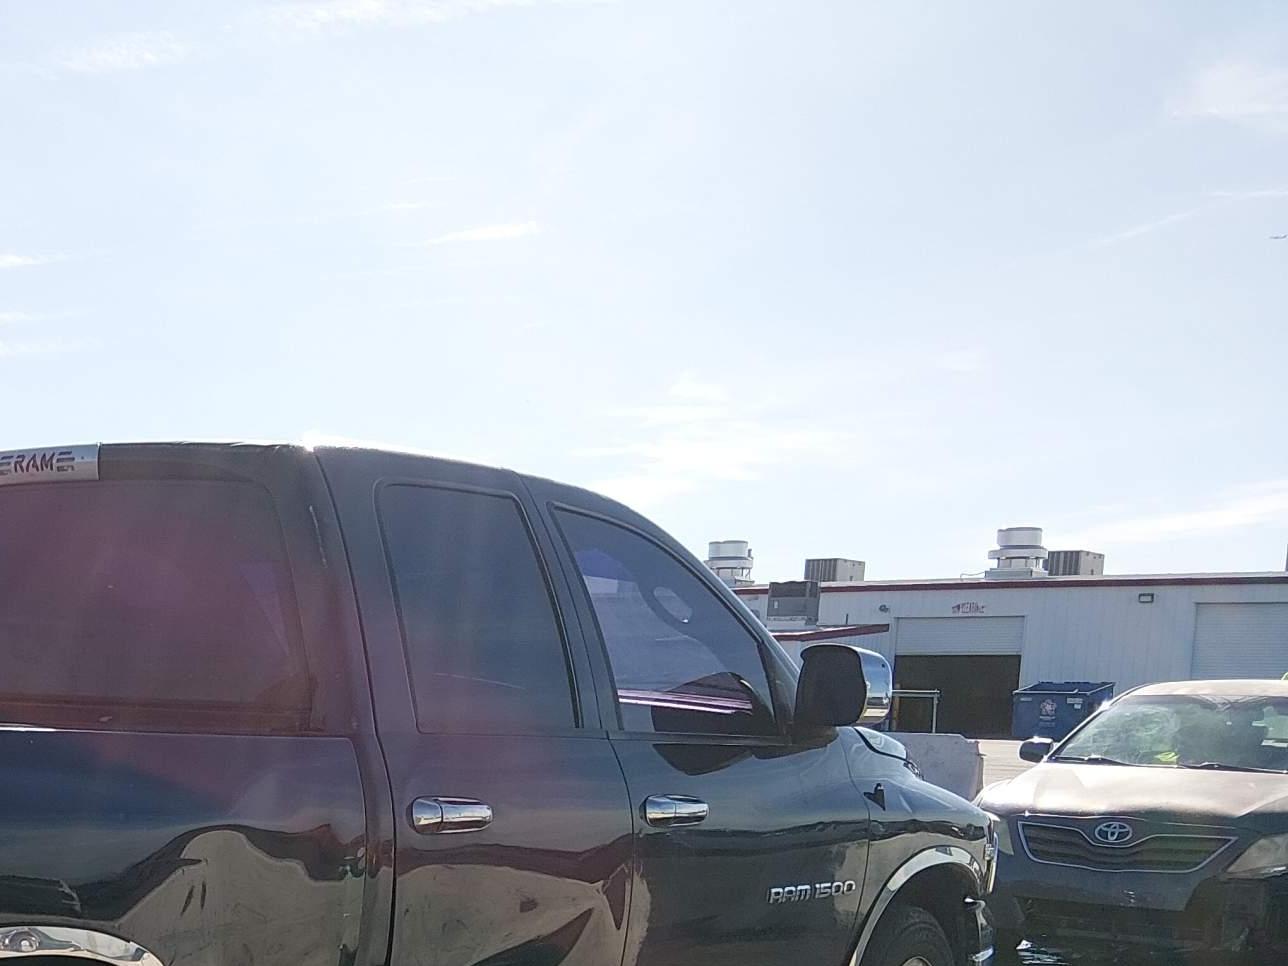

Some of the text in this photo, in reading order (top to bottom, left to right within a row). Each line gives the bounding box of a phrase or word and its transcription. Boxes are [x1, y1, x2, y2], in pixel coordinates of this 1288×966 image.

[13, 452, 56, 474] RAM
[768, 880, 856, 904] RAM 1500
